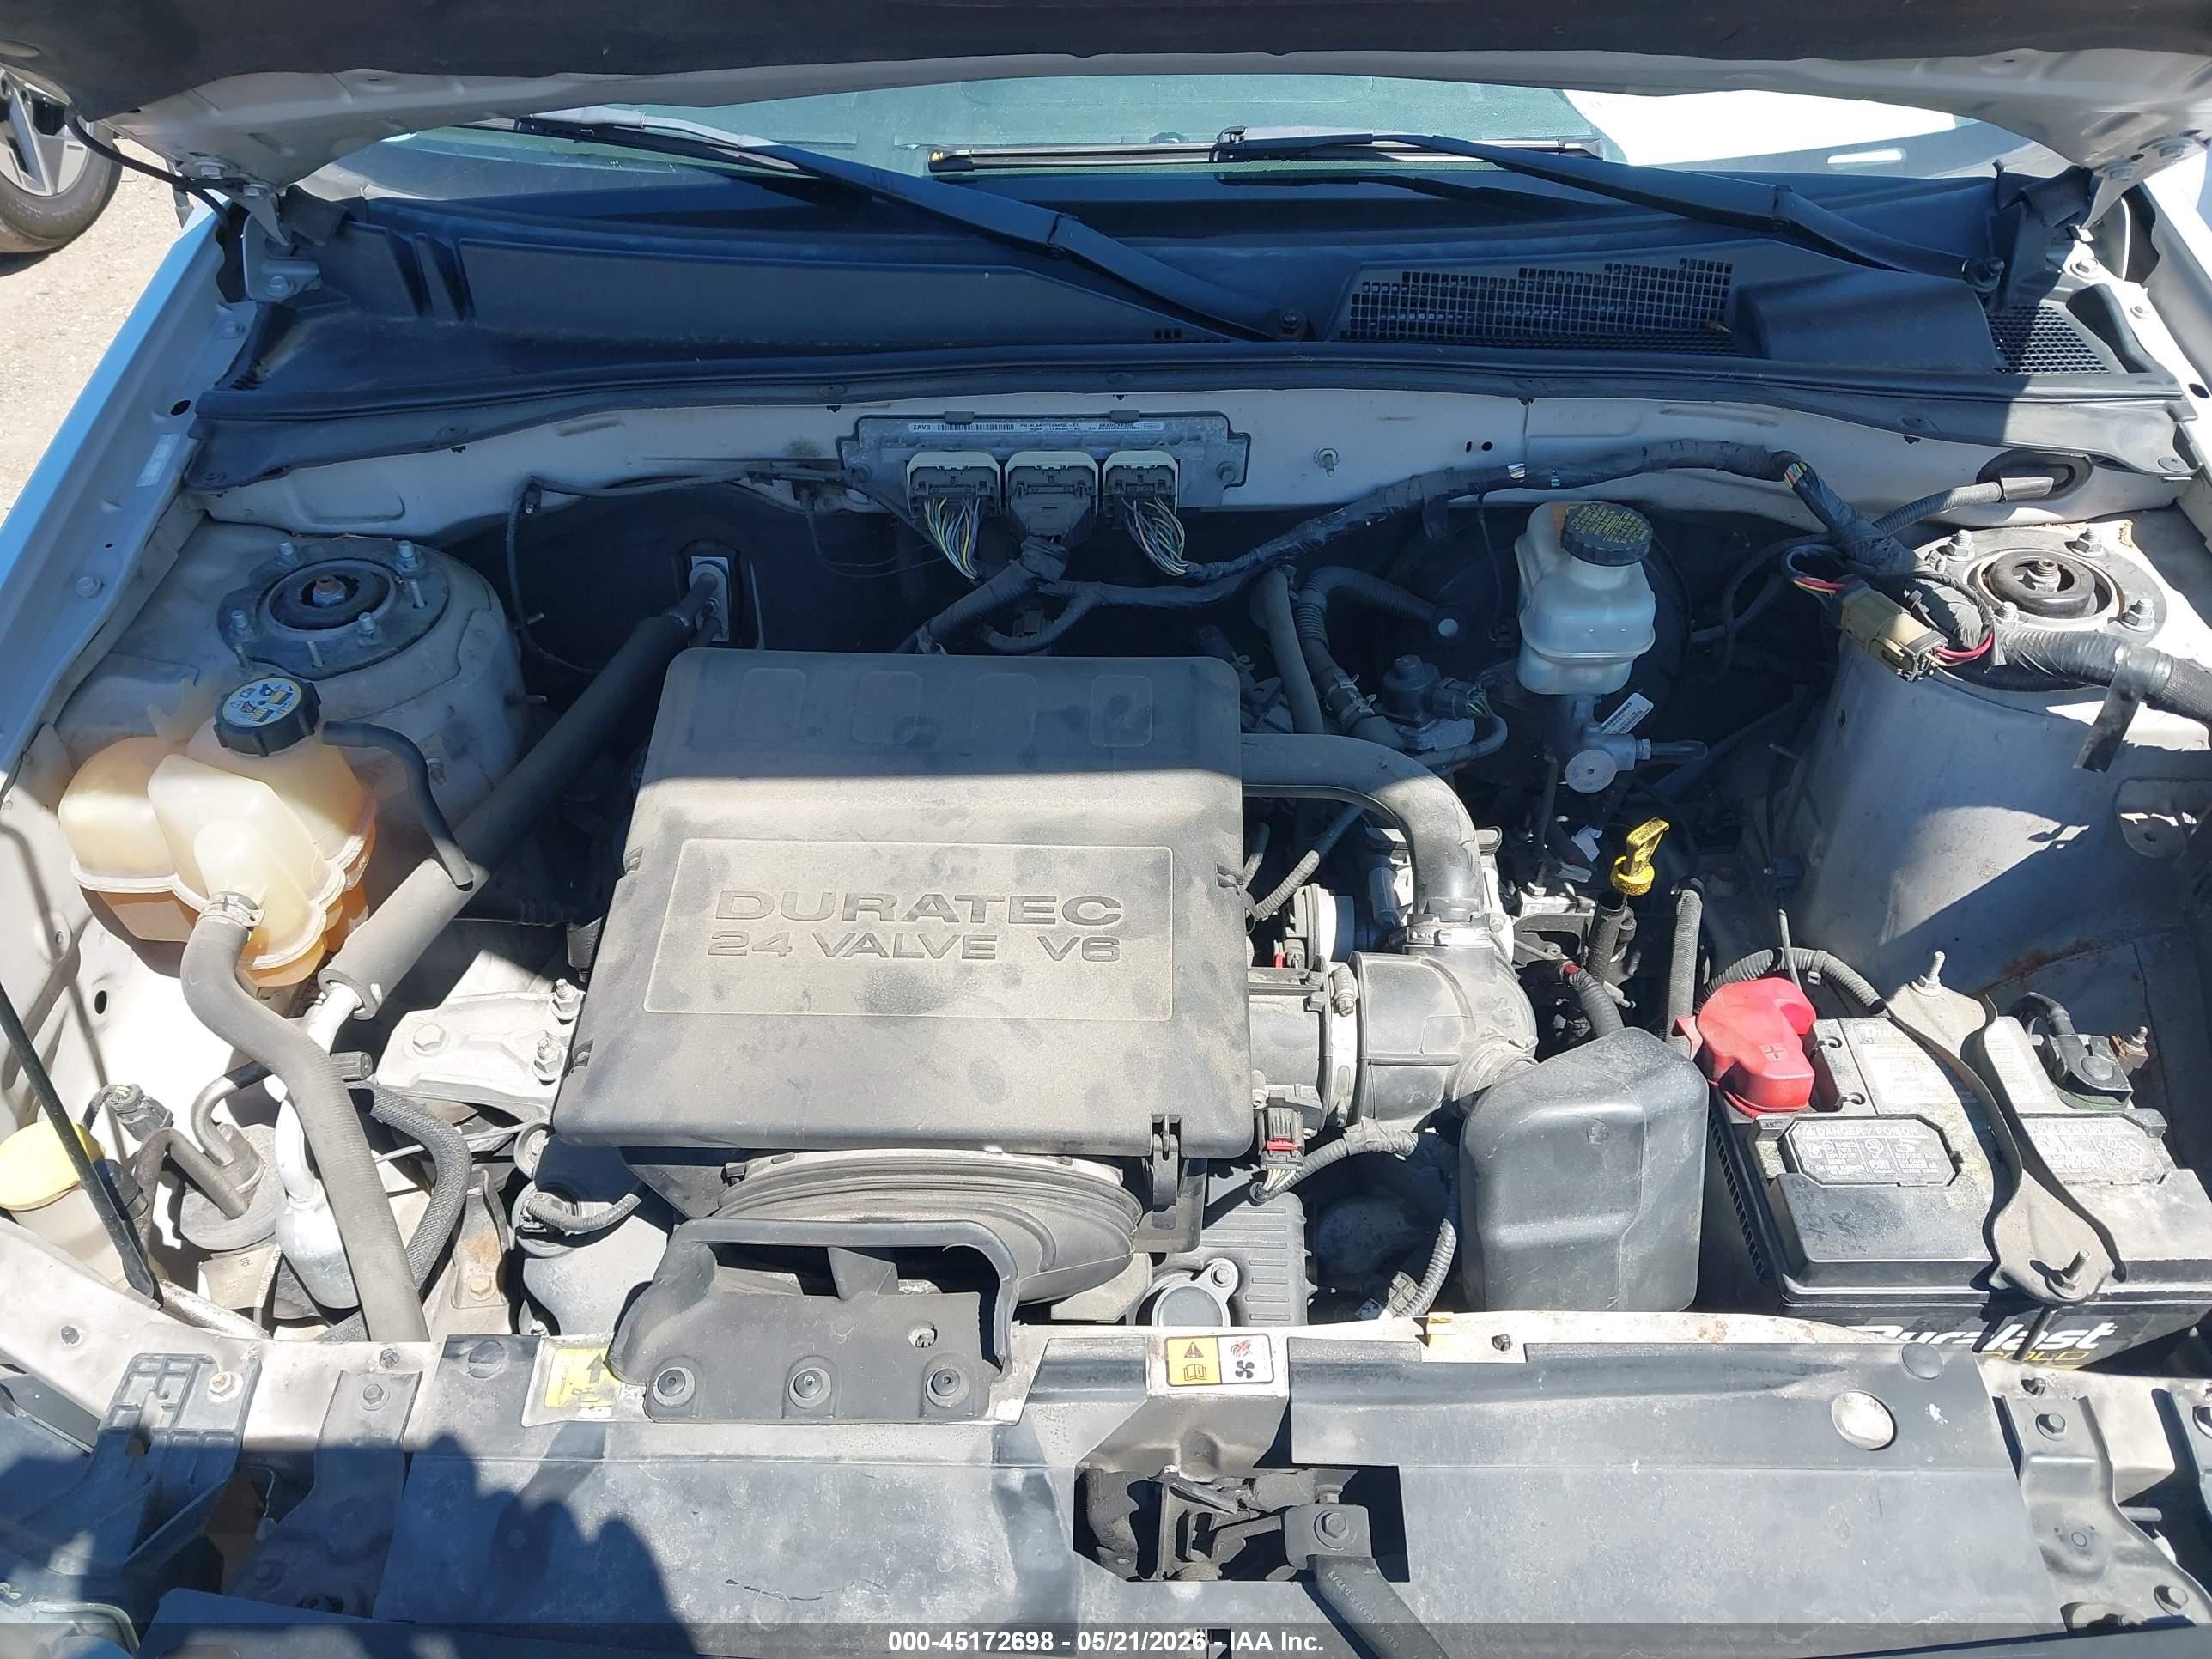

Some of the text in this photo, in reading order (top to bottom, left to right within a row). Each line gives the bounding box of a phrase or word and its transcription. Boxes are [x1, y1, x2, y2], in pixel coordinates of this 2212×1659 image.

[714, 890, 1123, 926] DURATEC
[707, 930, 1121, 963] 24 VALVE V6
[1815, 1127, 1864, 1136] DANGER
[1877, 1127, 1918, 1136] POISON
